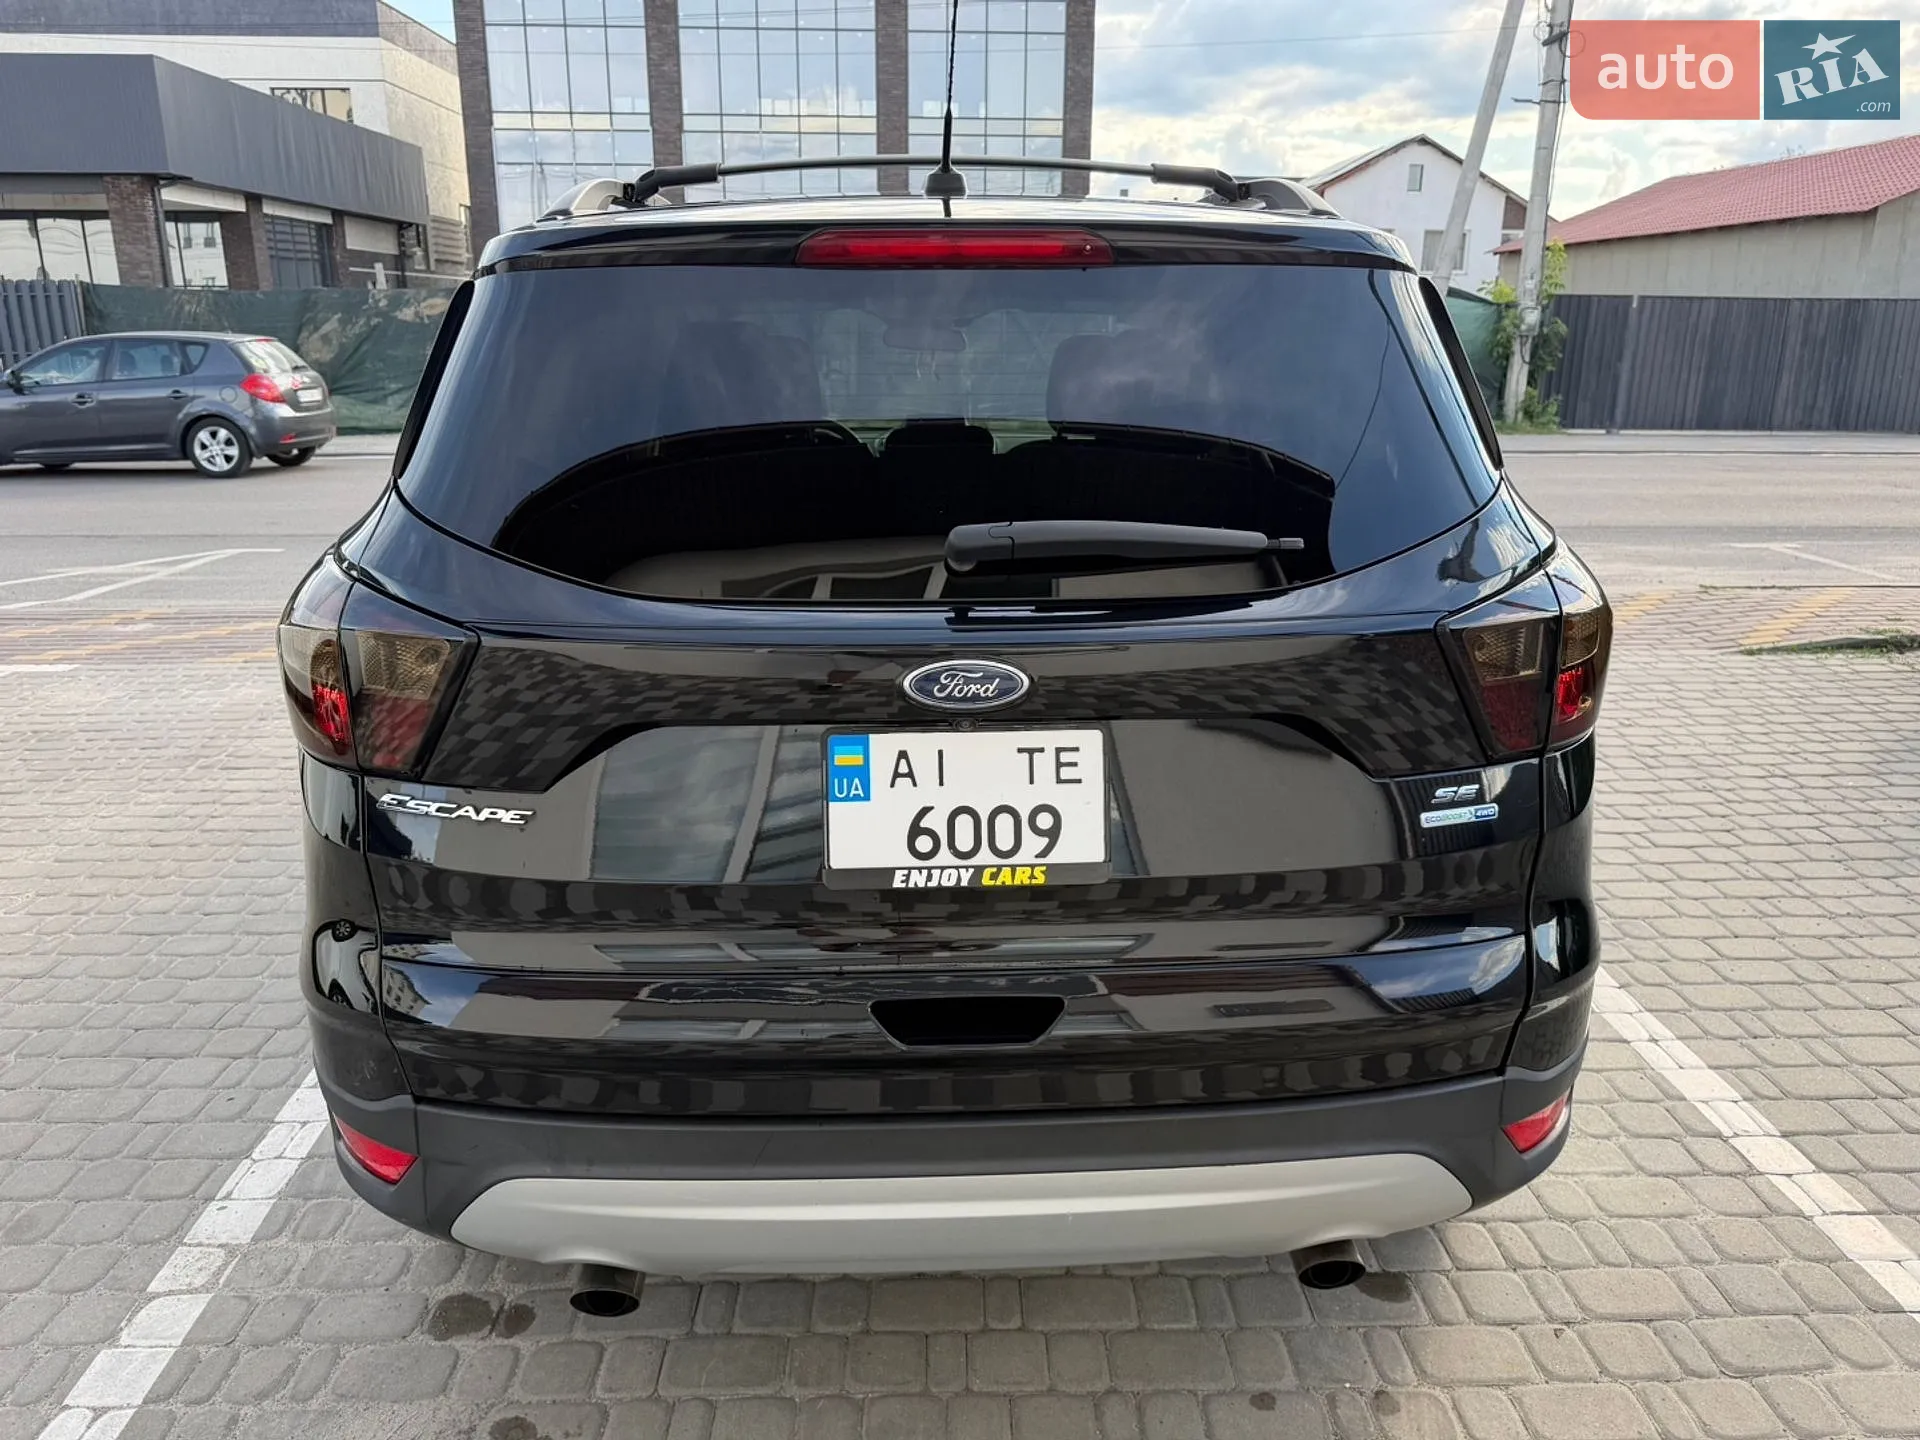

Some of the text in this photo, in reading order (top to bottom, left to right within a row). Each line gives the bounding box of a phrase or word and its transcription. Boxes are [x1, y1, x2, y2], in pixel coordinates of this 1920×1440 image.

[933, 670, 1001, 698] Ford
[889, 746, 1083, 789] AI TE
[834, 777, 865, 798] UA
[1430, 784, 1480, 804] SE
[376, 793, 534, 825] ESCAPE
[906, 803, 1063, 861] 6009
[892, 865, 1047, 888] ENJOY CARS
